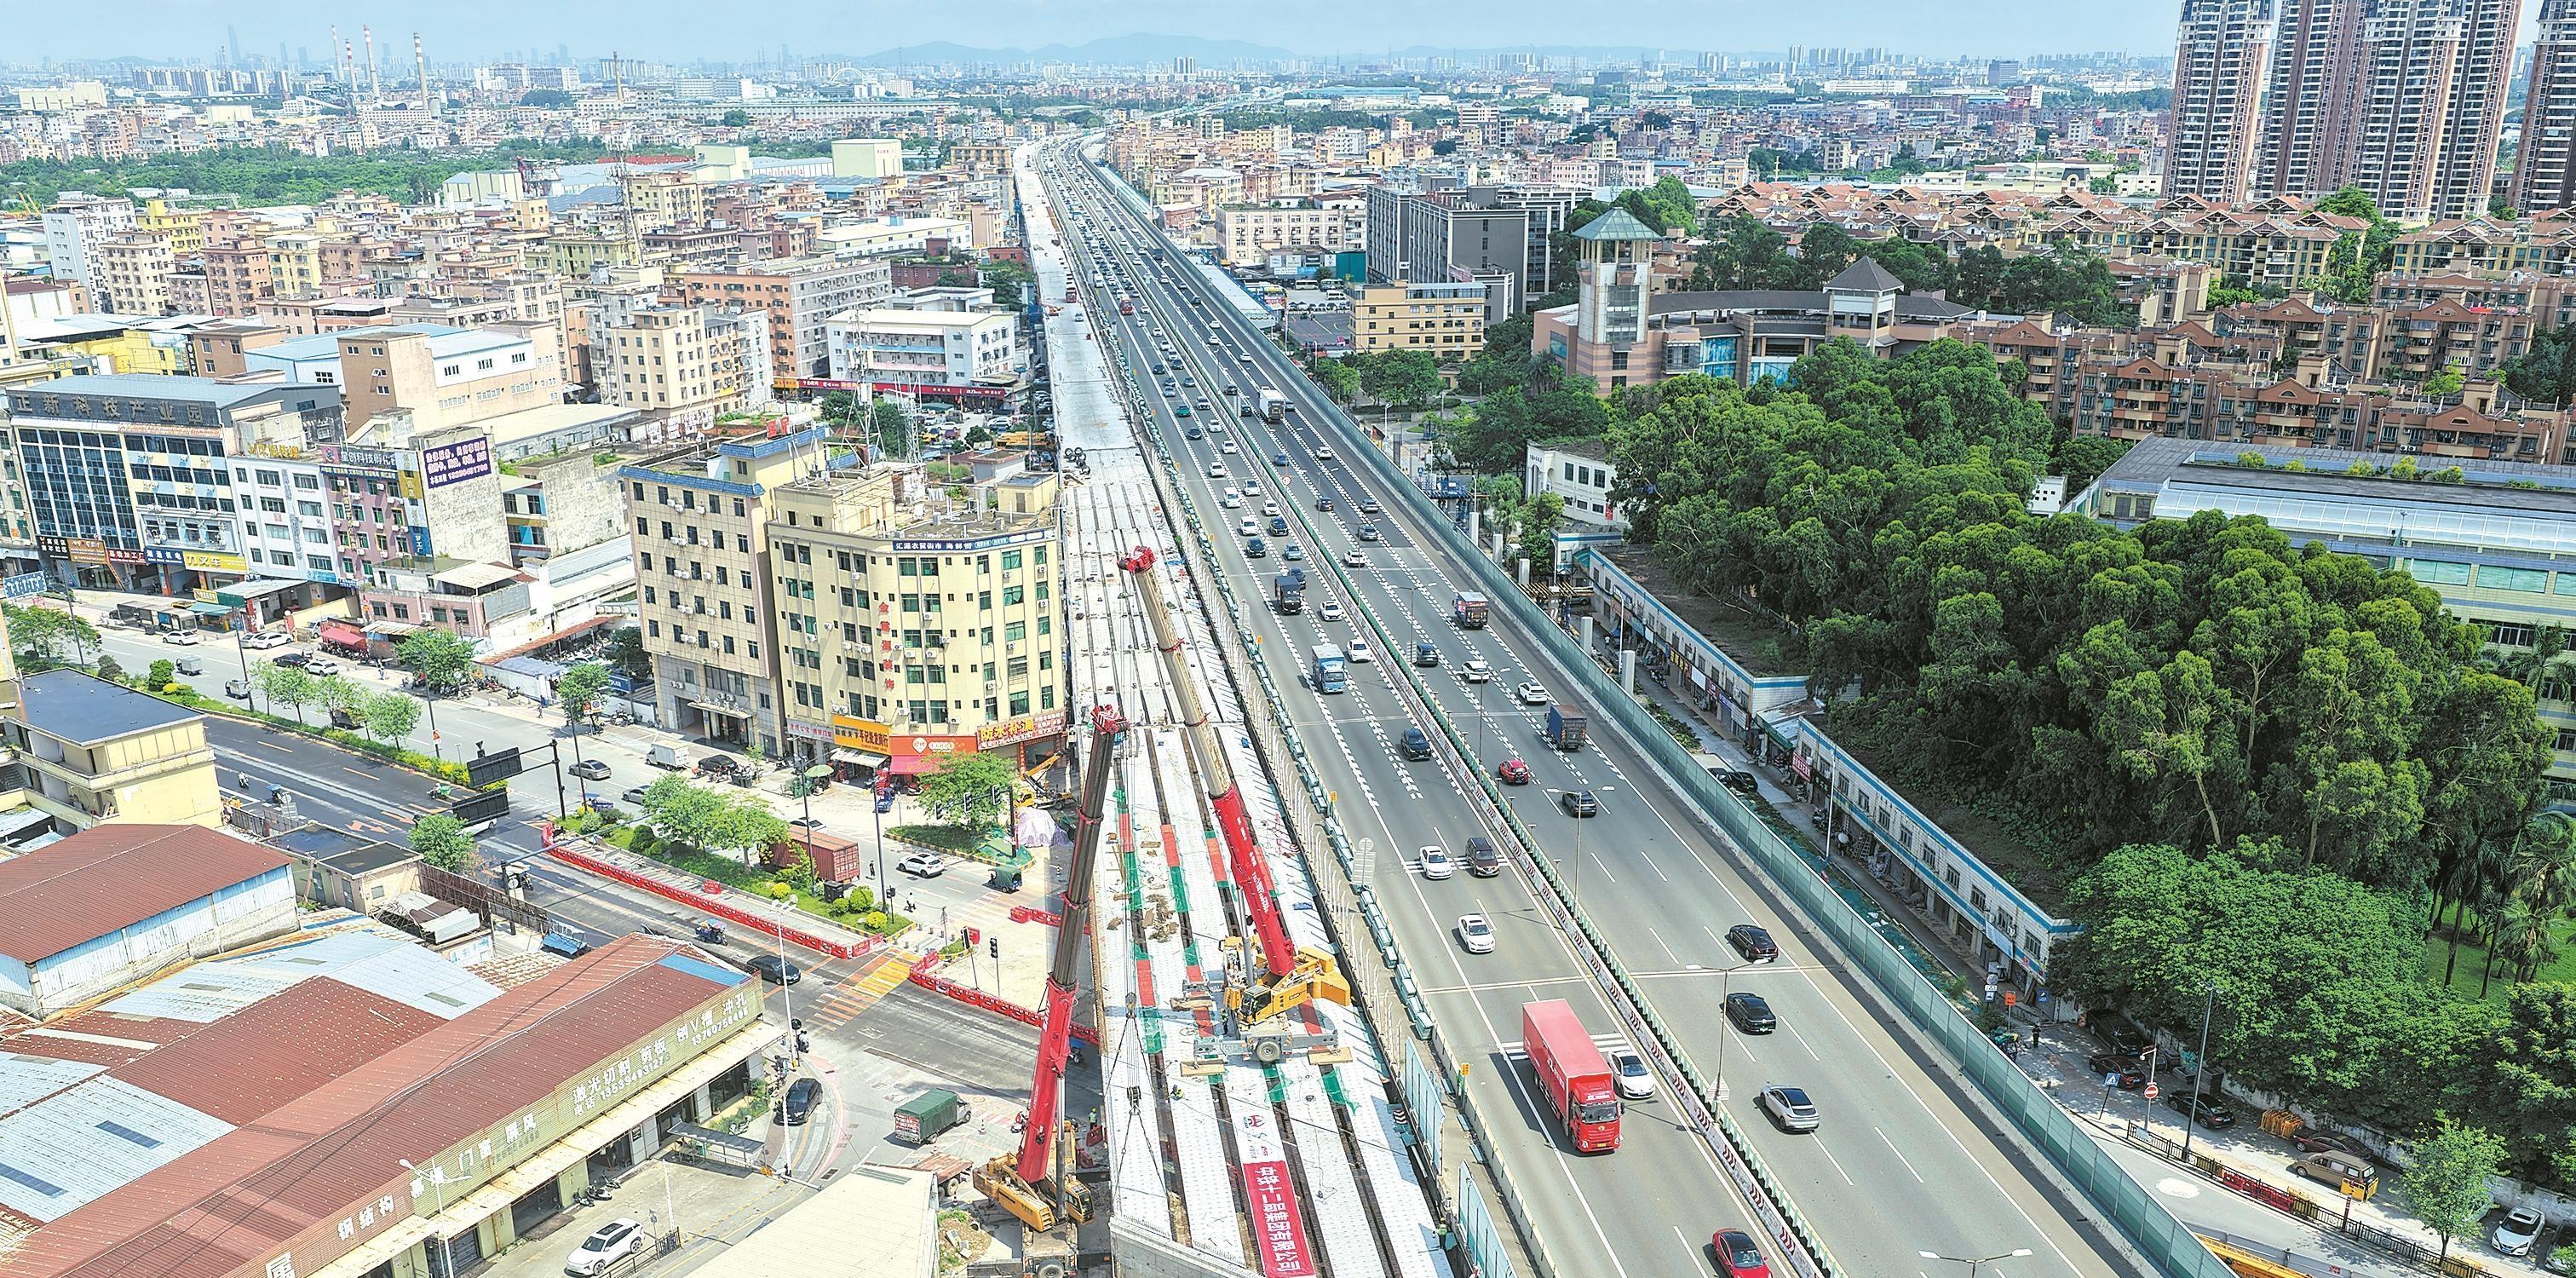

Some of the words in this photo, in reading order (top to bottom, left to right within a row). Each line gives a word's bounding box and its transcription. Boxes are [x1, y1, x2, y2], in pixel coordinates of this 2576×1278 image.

[17, 393, 203, 423] 正新科技产业园
[980, 718, 1034, 740] 防水补漏
[572, 1056, 631, 1105] 激光切割
[639, 1037, 667, 1065] 剪板
[722, 991, 747, 1016] 冲孔
[573, 1096, 596, 1117] 电话
[1254, 1166, 1302, 1272] 中铁十二局集团有限公司
